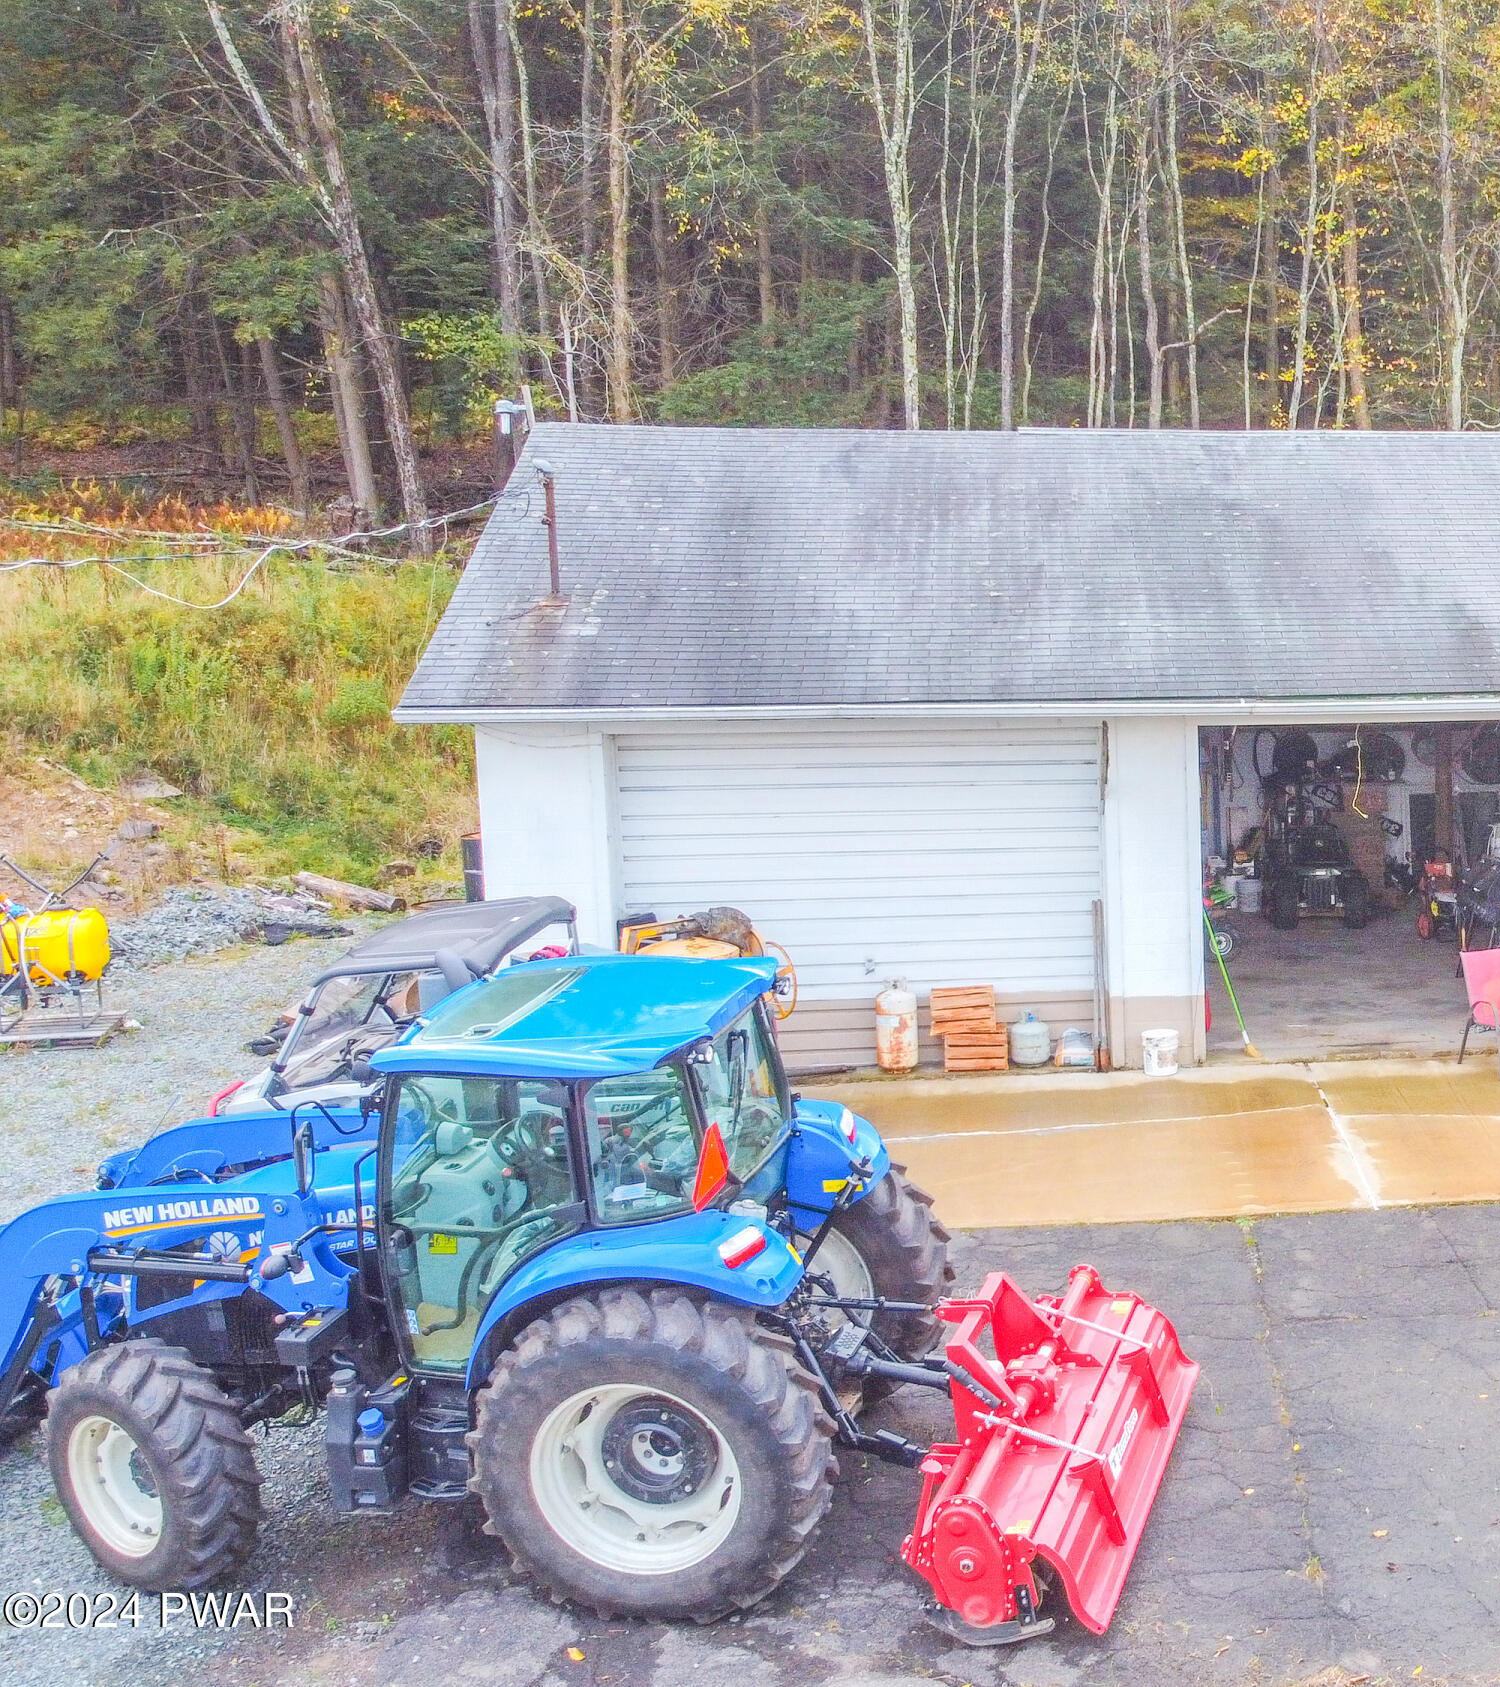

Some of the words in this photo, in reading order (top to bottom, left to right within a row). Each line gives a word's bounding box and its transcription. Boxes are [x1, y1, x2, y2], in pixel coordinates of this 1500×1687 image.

[103, 1205, 154, 1229] NEW
[157, 1197, 260, 1221] HOLLAND
[321, 1204, 377, 1225] LAND
